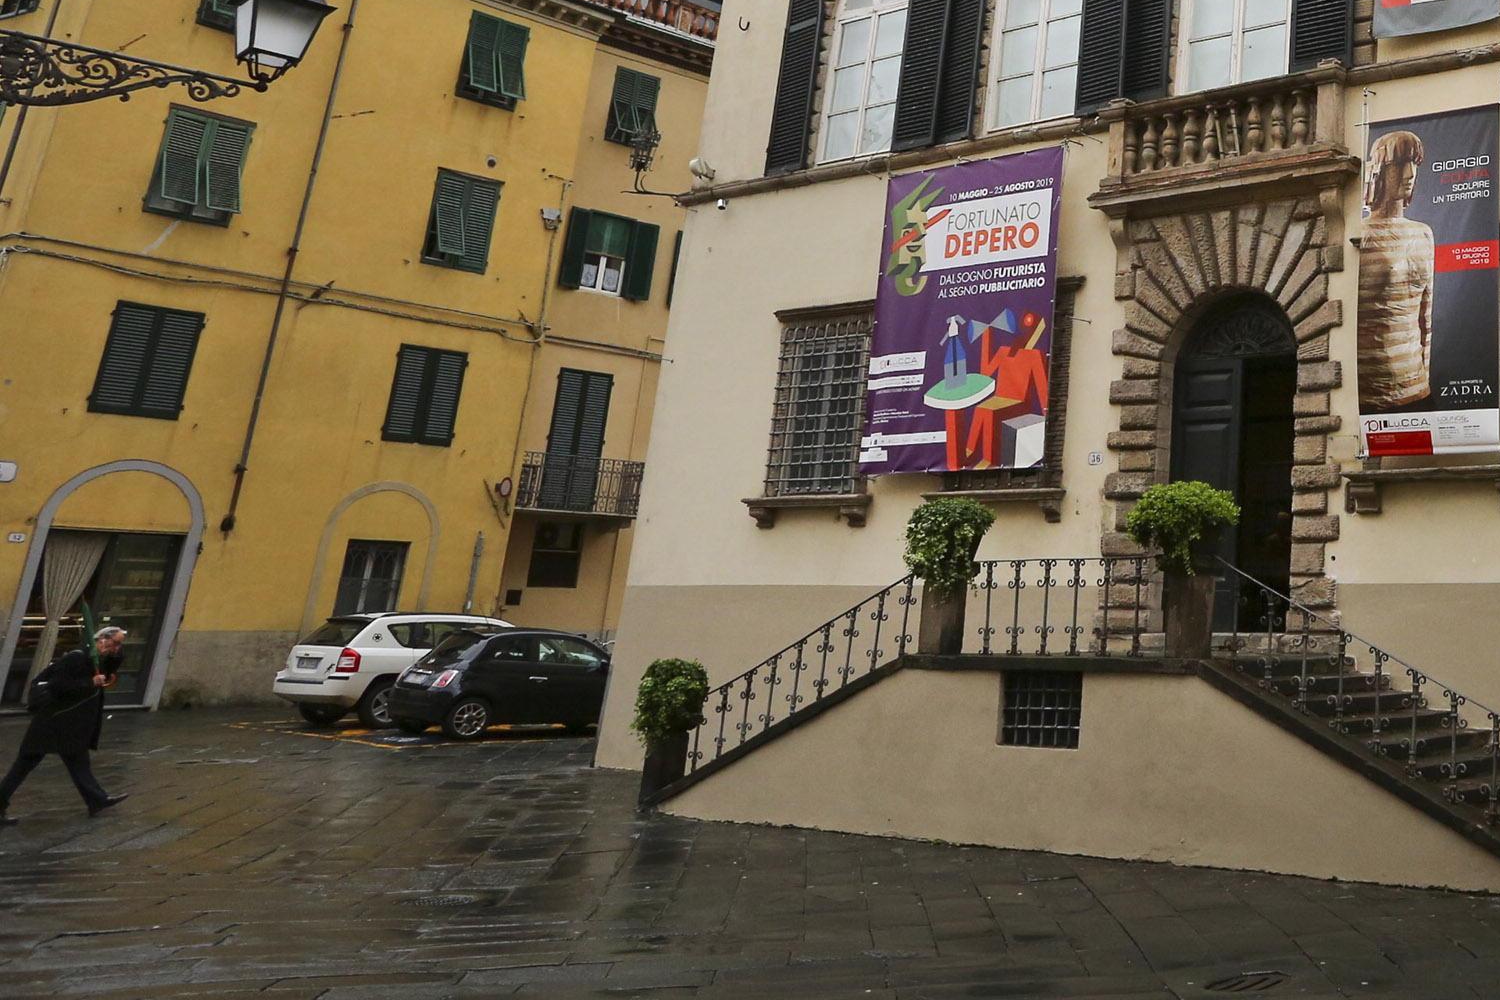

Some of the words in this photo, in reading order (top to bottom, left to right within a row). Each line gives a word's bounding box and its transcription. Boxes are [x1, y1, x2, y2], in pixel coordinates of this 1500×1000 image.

[1432, 155, 1490, 172] GIORGIO
[949, 193, 957, 202] 10
[958, 188, 988, 201] MAGGIO
[994, 186, 1003, 195] 25
[1004, 180, 1035, 192] AGOSTO
[1036, 177, 1054, 188] 2019
[1432, 195, 1444, 204] UN
[1446, 190, 1490, 202] TERRITORIO
[1452, 180, 1490, 192] SCOLPIRE
[947, 202, 1041, 232] FORTUNATO
[944, 221, 1040, 258] DEPERO
[940, 274, 957, 286] DAL
[957, 269, 993, 284] SOGNO
[993, 262, 1046, 279] FUTURISTA
[938, 288, 948, 299] AL
[949, 285, 979, 298] SEGNO
[979, 277, 1046, 294] PUBBLICITARIO
[1440, 384, 1492, 396] ZADRA
